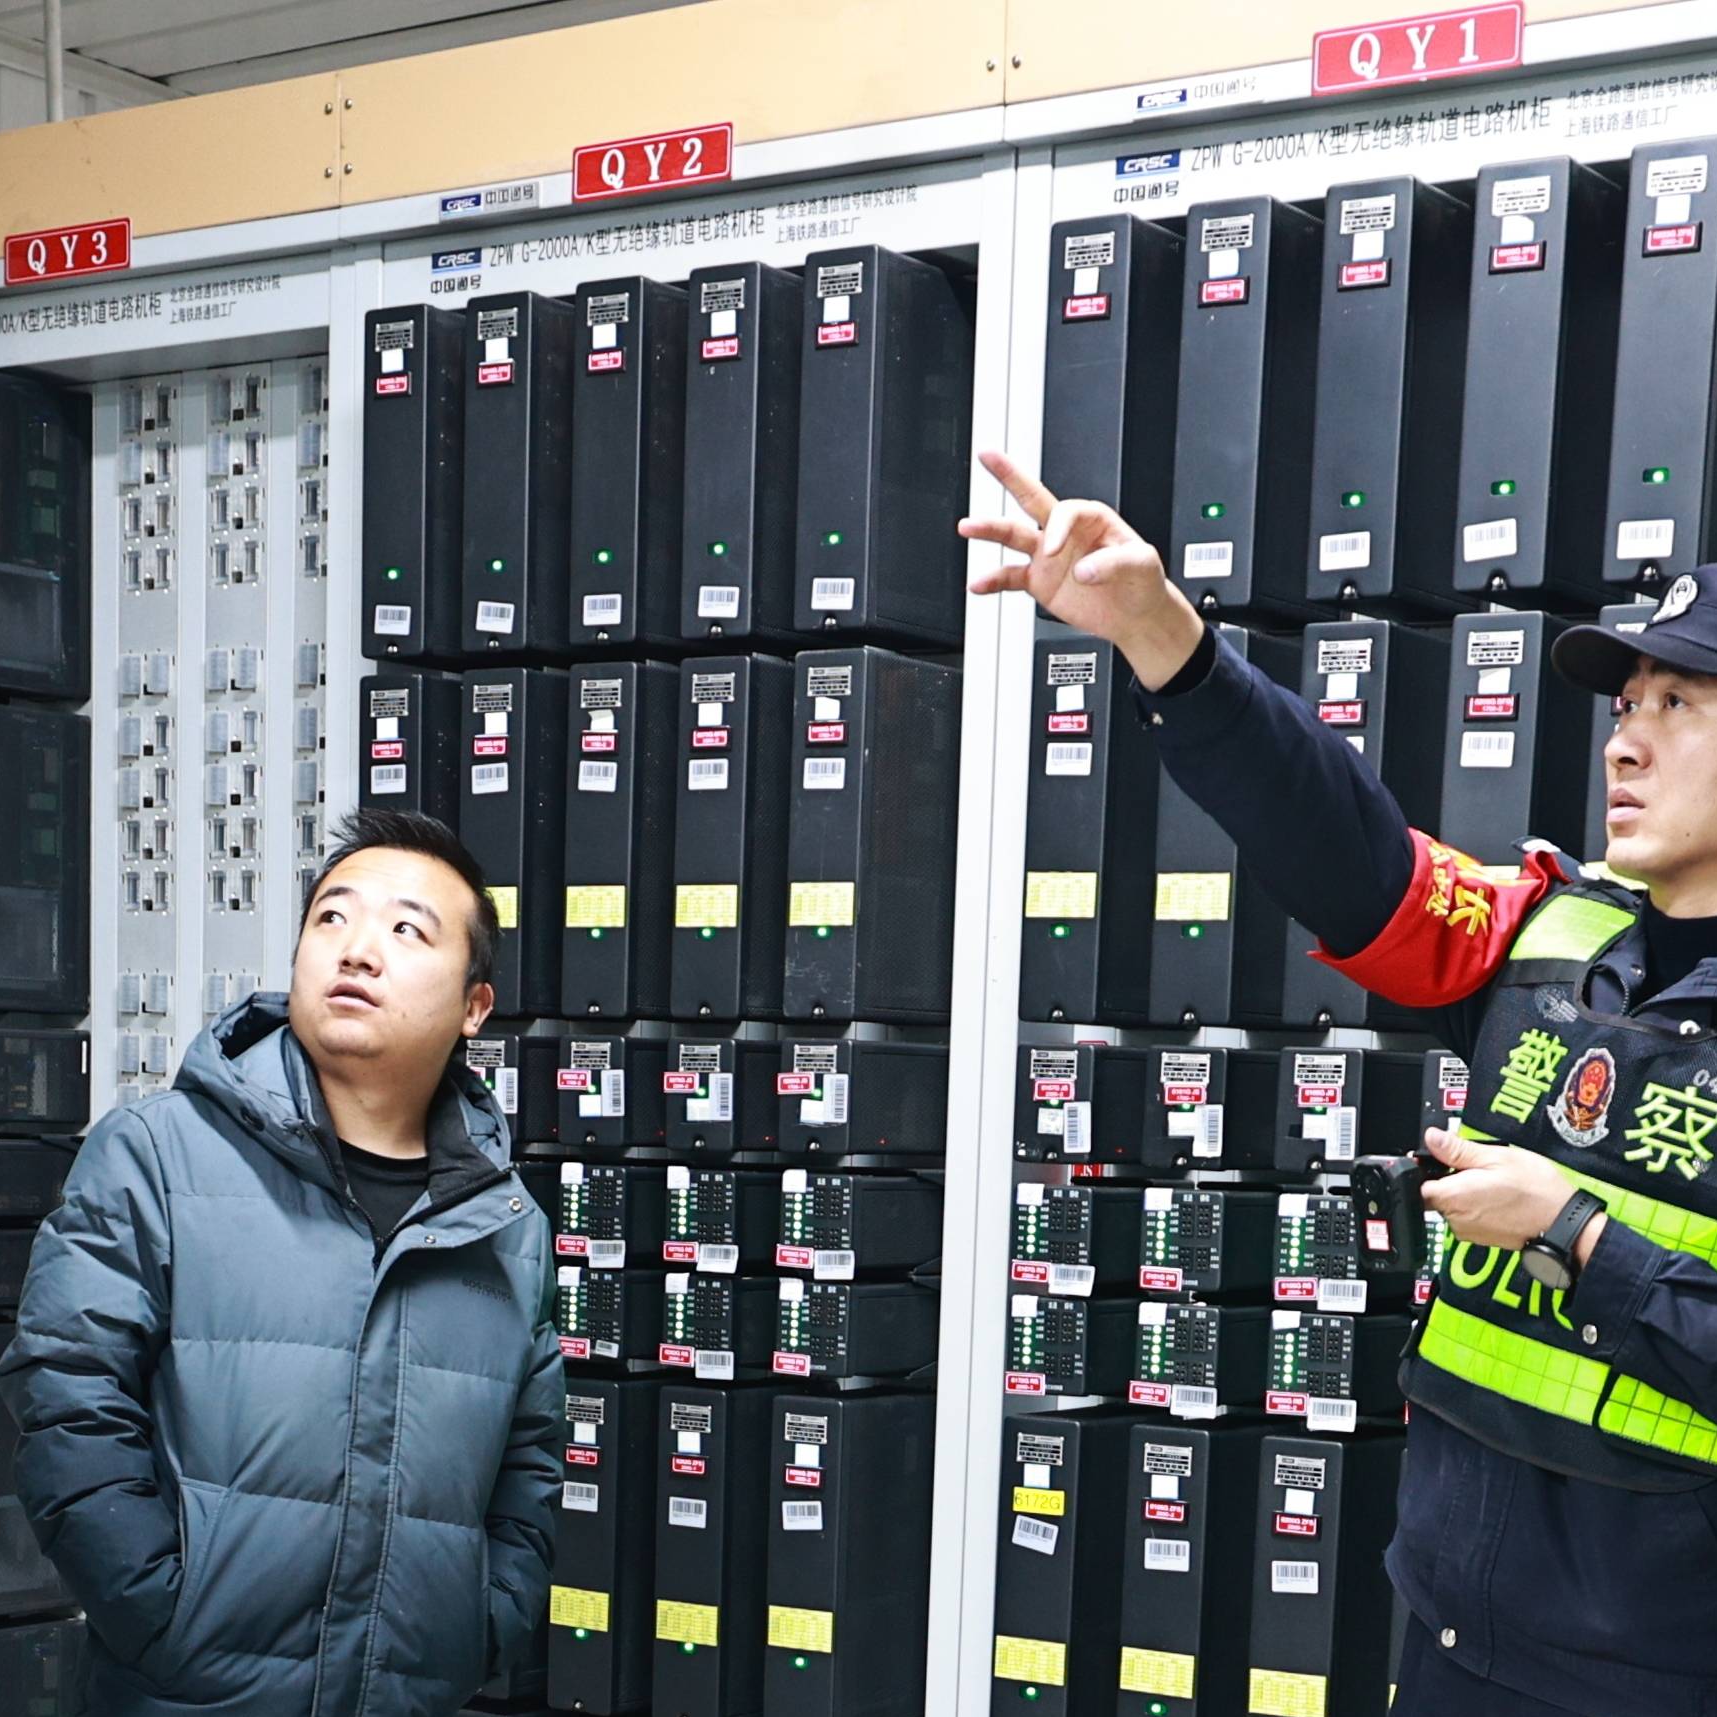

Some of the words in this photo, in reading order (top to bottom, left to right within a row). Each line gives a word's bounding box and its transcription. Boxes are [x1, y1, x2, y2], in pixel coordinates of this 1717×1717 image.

[1349, 26, 1479, 80] QY1
[601, 138, 703, 190] QY2
[1123, 154, 1174, 172] CRSC
[485, 185, 534, 206] 中国通号
[1114, 180, 1179, 204] 中国通号
[27, 231, 108, 275] QY3
[436, 251, 477, 267] CRSC
[431, 274, 481, 294] 中国通号
[1490, 1028, 1568, 1124] 警
[1014, 1492, 1061, 1511] 6172G
